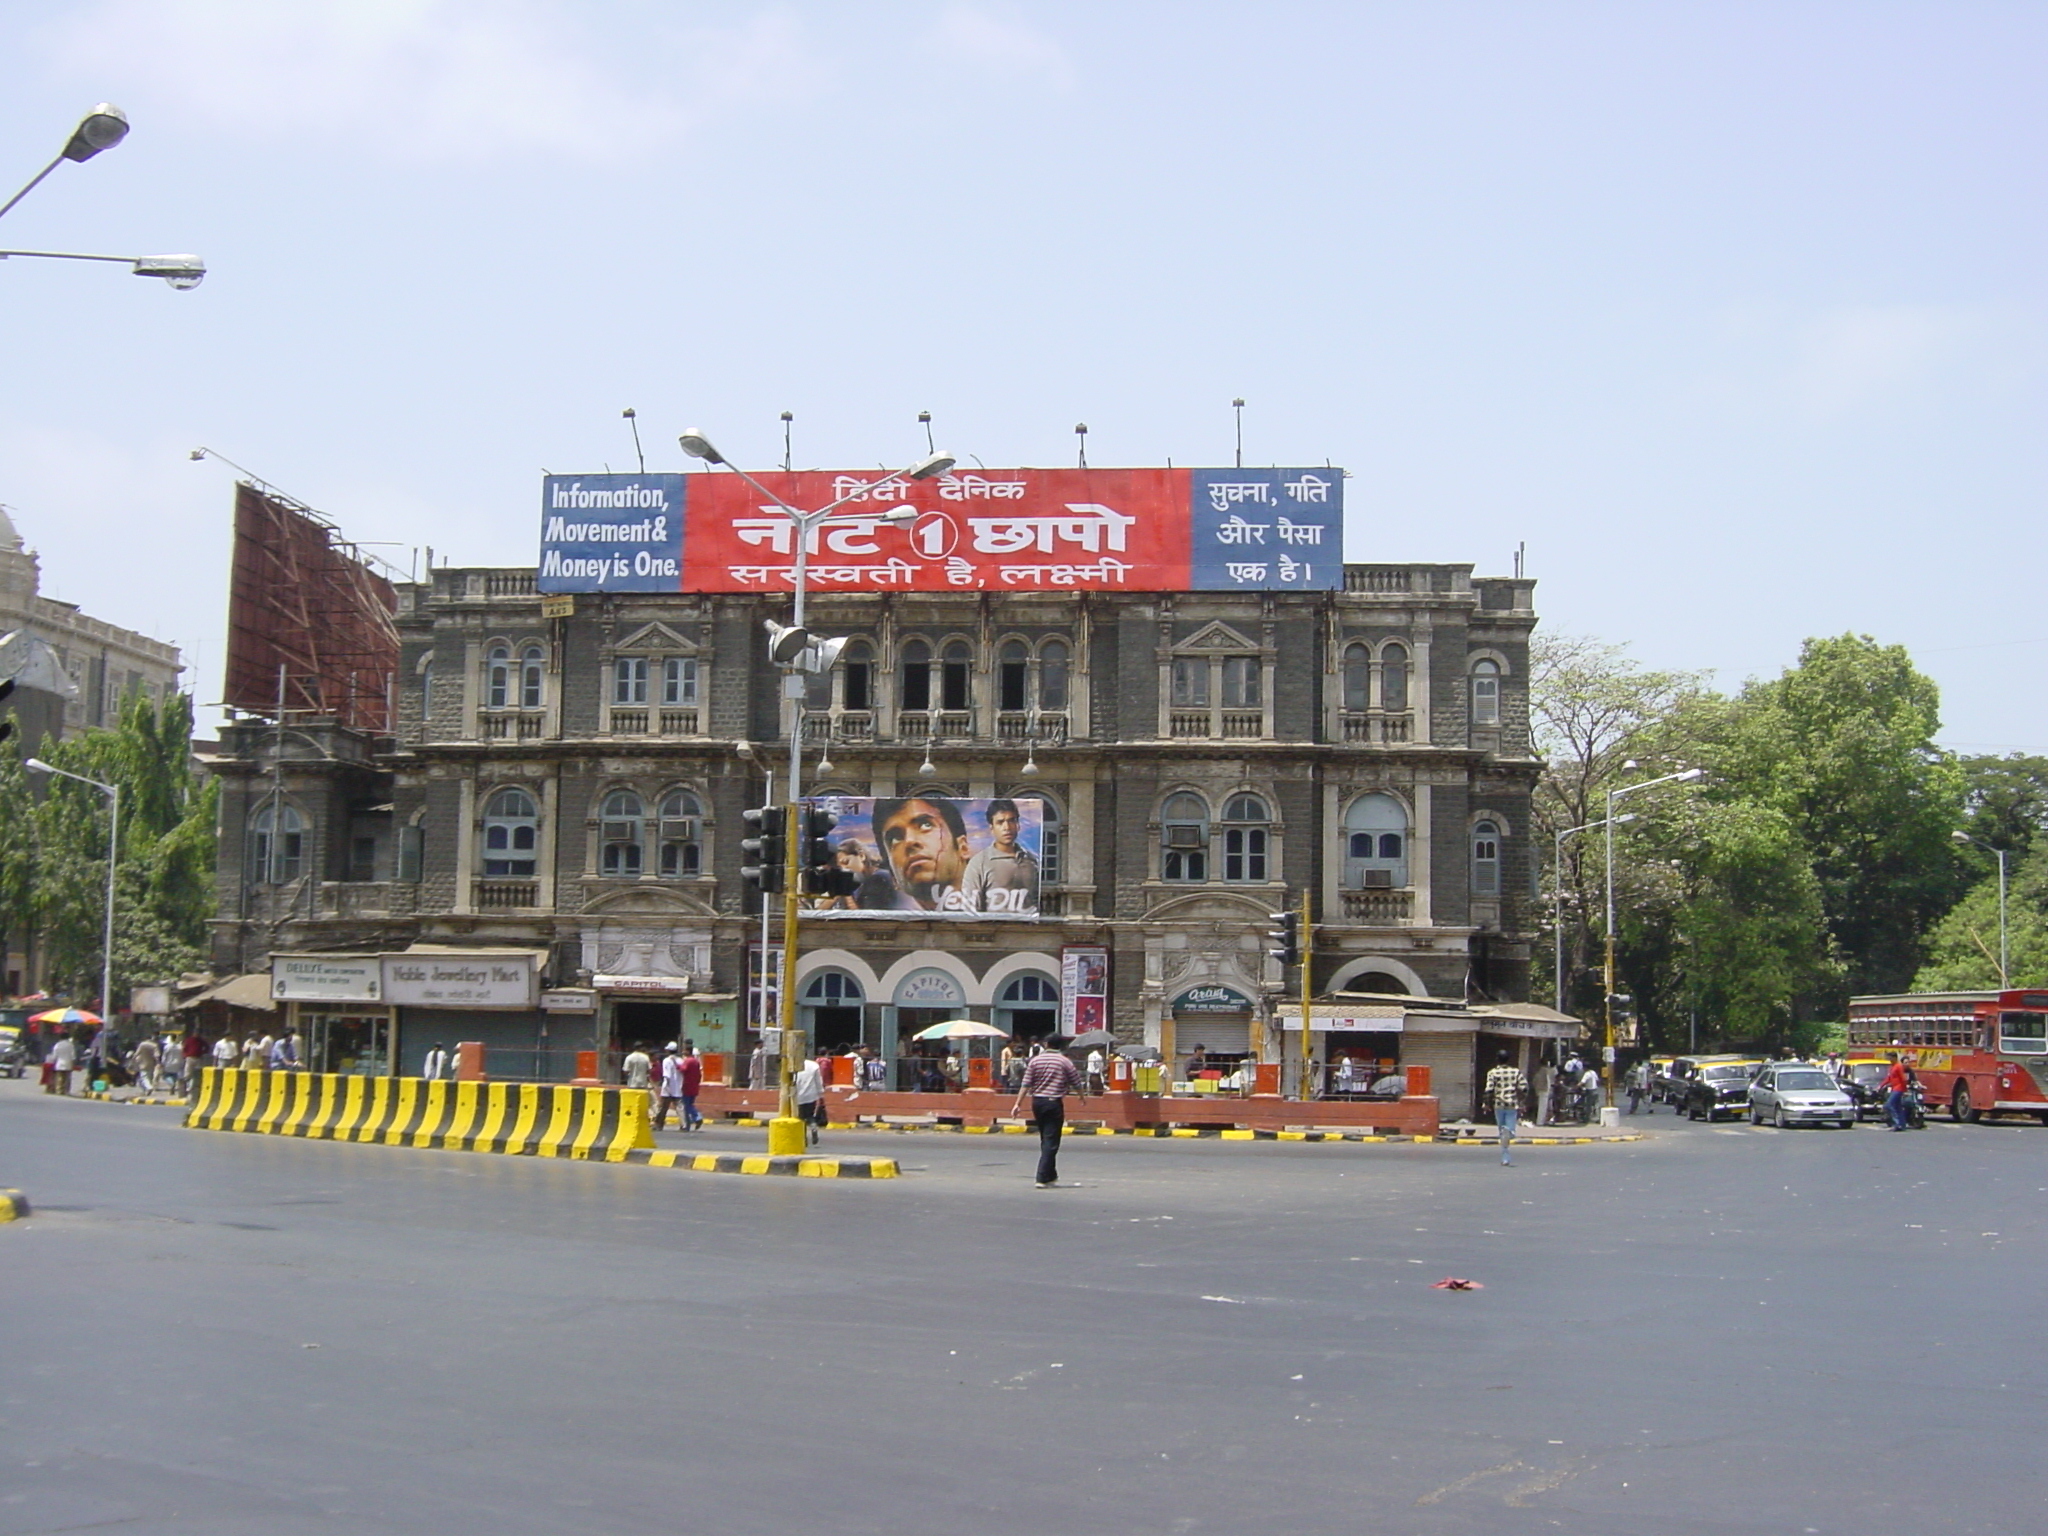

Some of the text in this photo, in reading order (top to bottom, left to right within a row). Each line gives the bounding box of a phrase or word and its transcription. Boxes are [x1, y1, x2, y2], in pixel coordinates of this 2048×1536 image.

[553, 483, 669, 512] Information,
[832, 475, 1027, 502] हिंदी दैनिक
[1207, 474, 1331, 511] सुचना, गति
[732, 503, 1136, 555] नोट 1 छापो
[1216, 514, 1324, 545] और पैसा
[542, 550, 679, 584] Money is One.
[728, 557, 921, 584] सरस्वती
[1000, 557, 1133, 585] लक्ष्मी
[1225, 563, 1268, 583] एक
[492, 966, 520, 982] Mart
[613, 980, 667, 989] CAPITOL
[904, 977, 954, 998] CAPITOL
